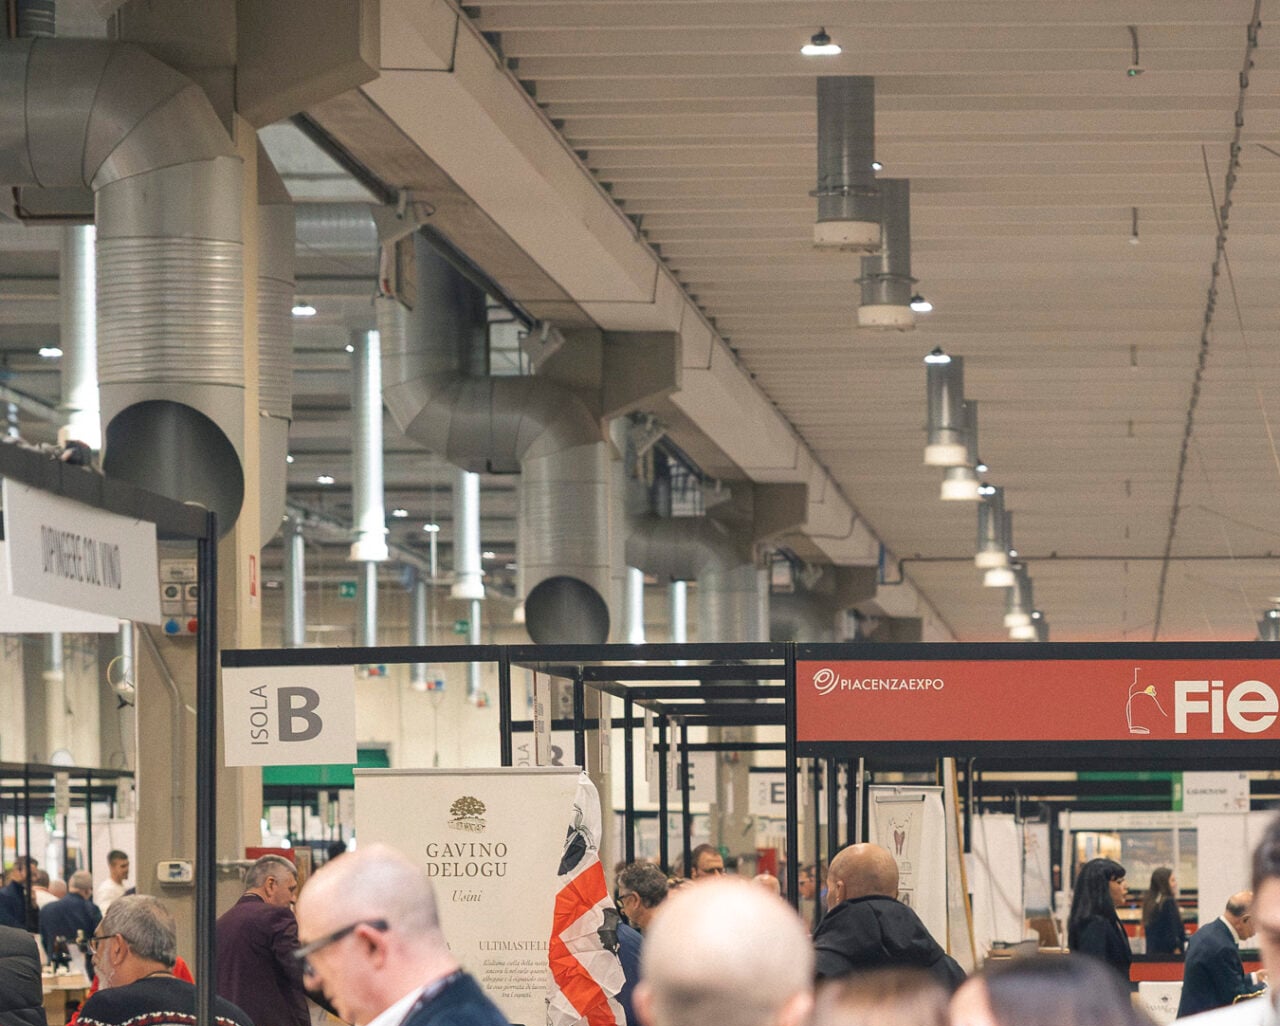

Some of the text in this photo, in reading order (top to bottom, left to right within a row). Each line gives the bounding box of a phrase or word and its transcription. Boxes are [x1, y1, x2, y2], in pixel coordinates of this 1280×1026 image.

[840, 678, 944, 691] PIACENZAEXPO
[249, 684, 323, 745] ISOLA B
[426, 842, 508, 858] GAVINO
[426, 862, 508, 877] DELOGU
[479, 940, 550, 951] ULTIMASTELL
